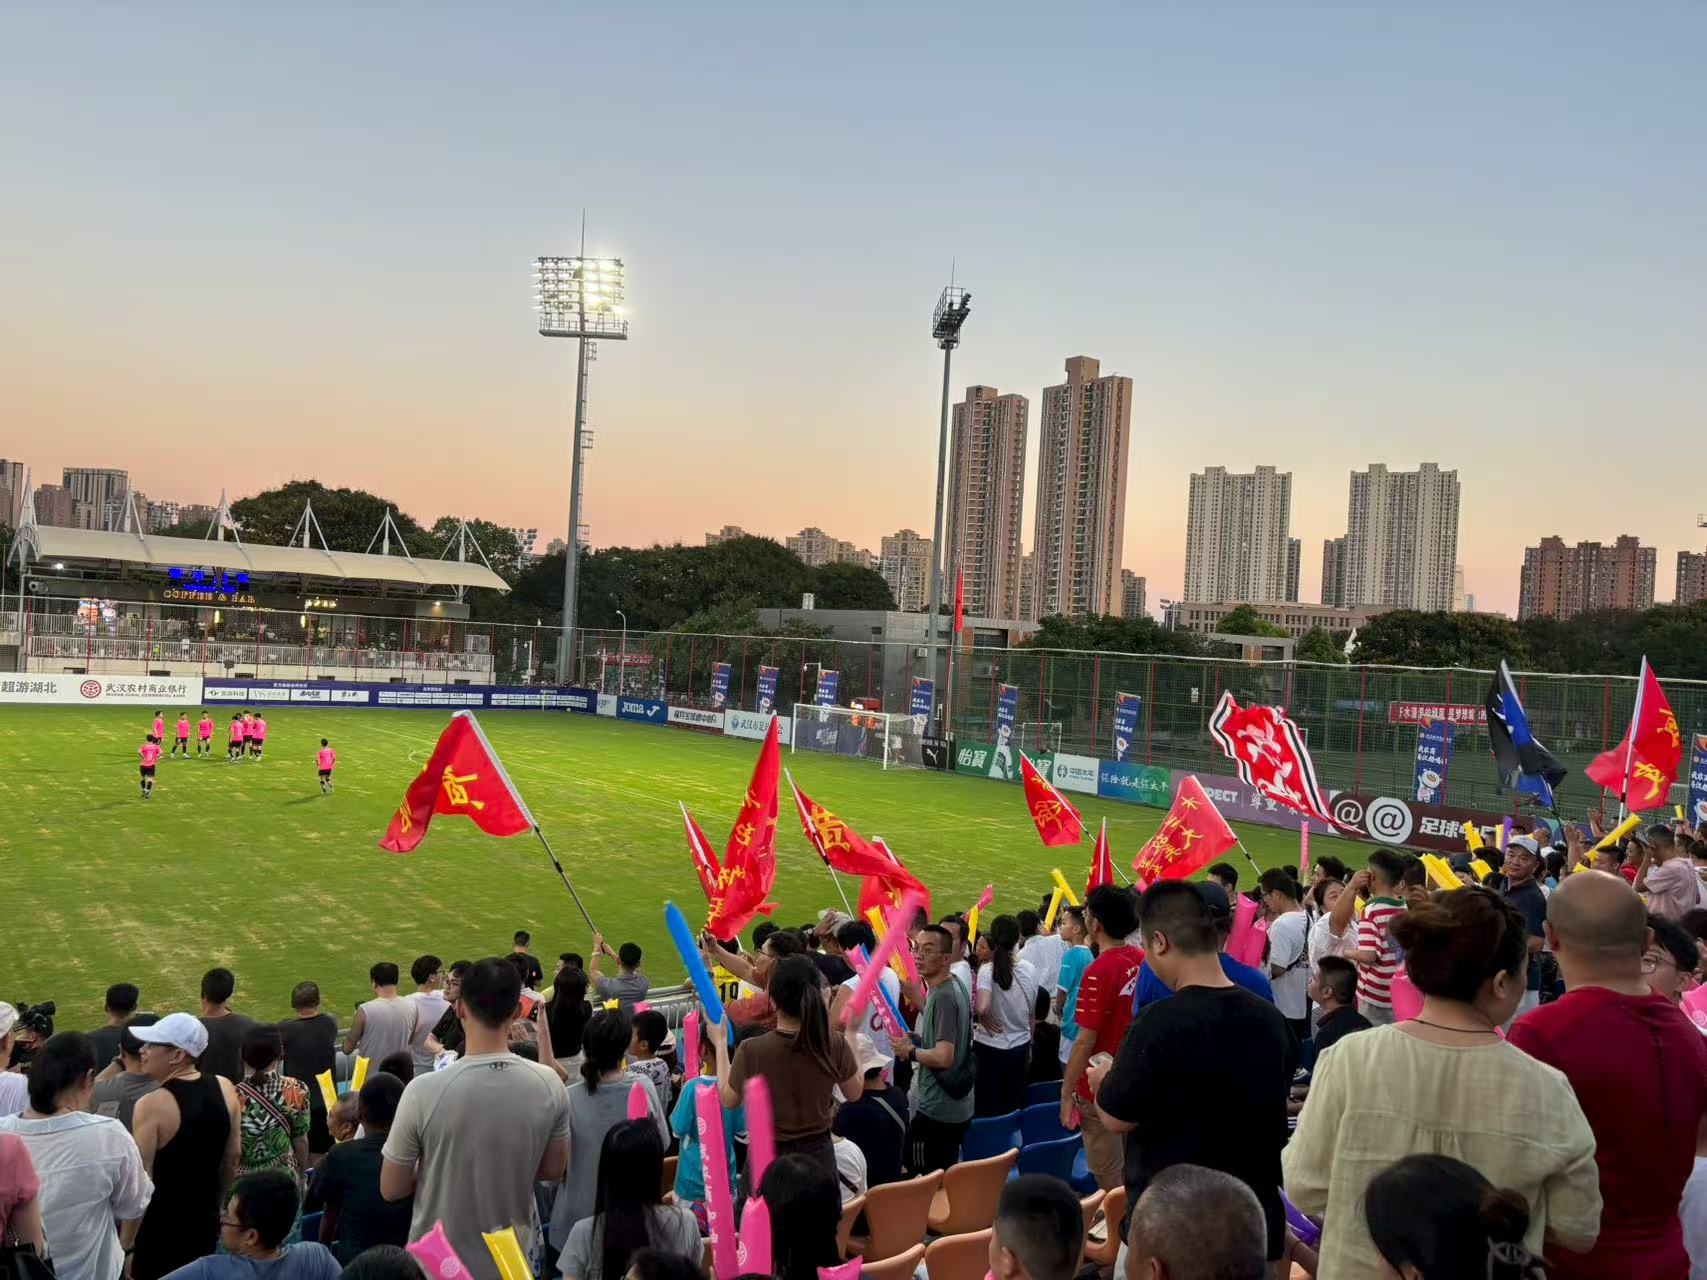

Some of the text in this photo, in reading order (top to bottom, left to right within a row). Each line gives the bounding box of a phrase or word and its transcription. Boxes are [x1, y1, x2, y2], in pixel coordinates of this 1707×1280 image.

[105, 683, 187, 693] 武汉农村商业银行
[1101, 772, 1169, 792] 保险就是保太平
[1207, 787, 1239, 803] PECT
